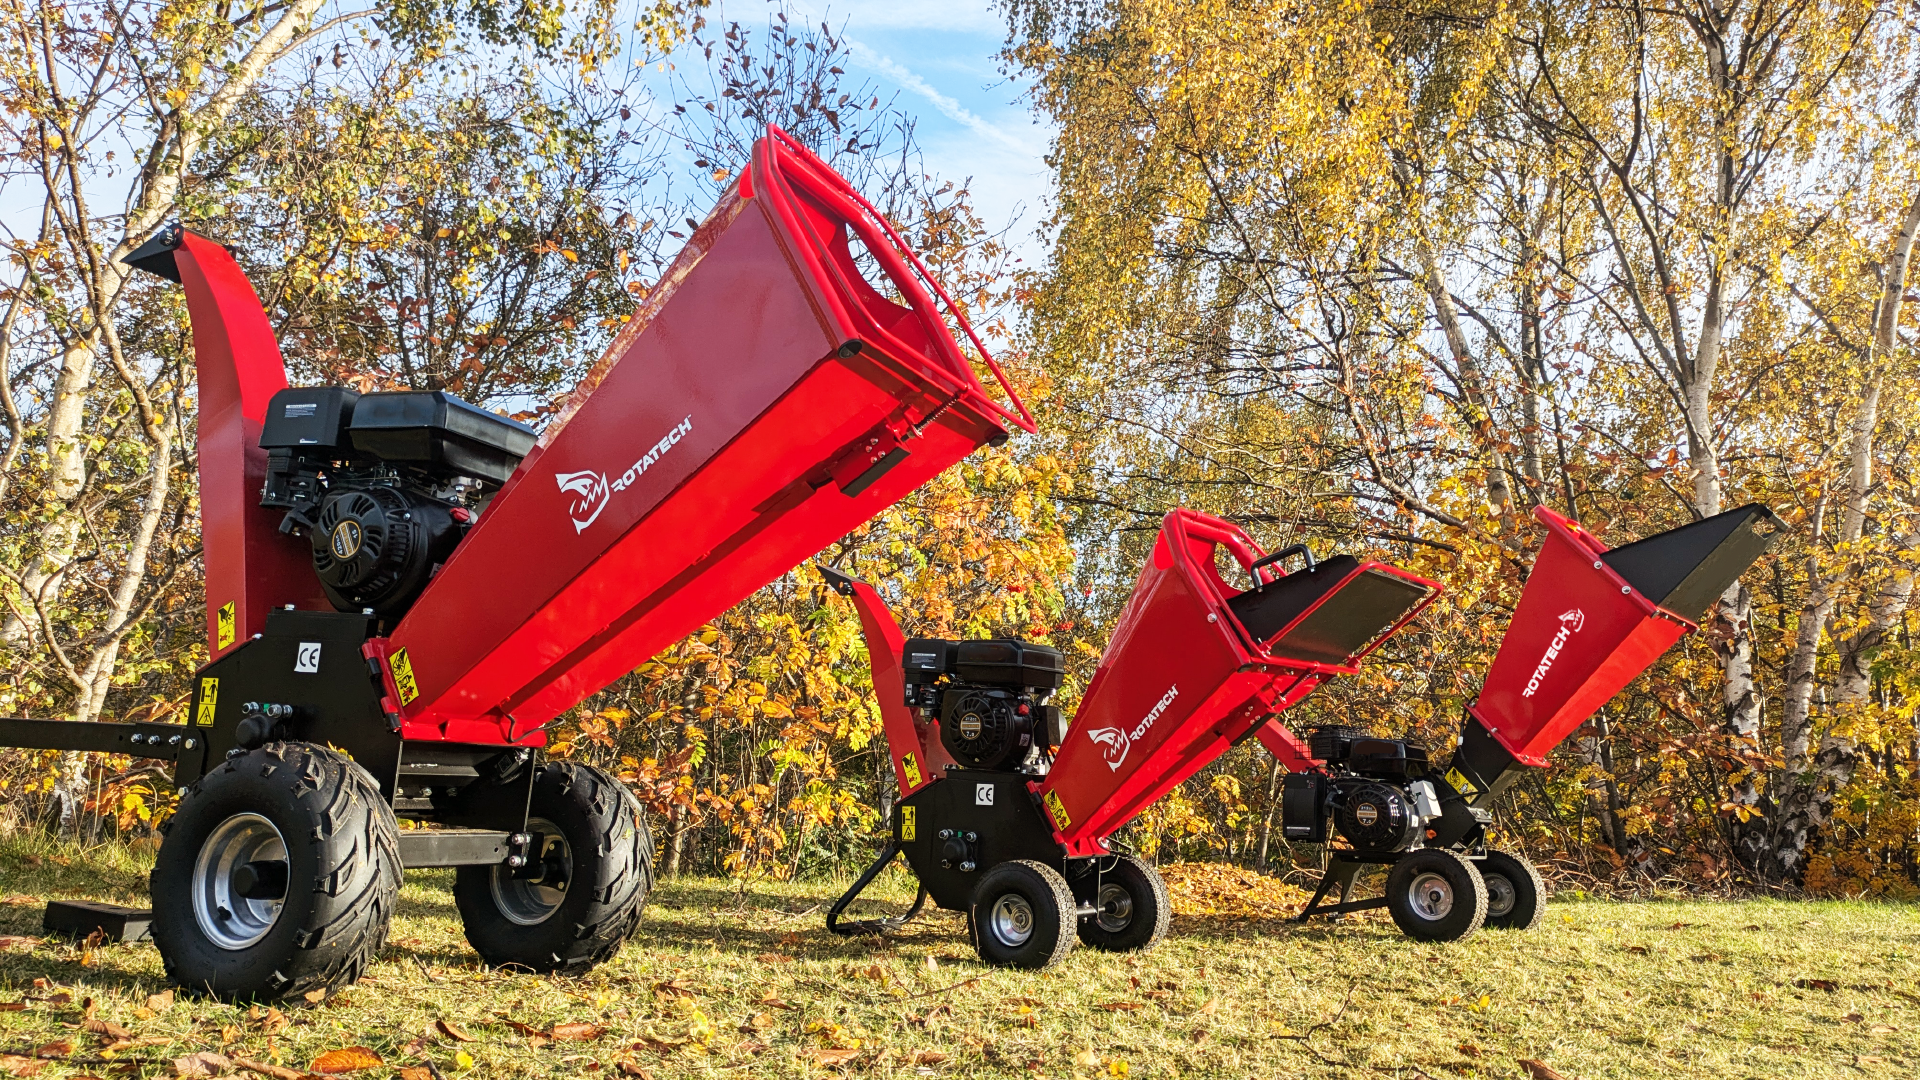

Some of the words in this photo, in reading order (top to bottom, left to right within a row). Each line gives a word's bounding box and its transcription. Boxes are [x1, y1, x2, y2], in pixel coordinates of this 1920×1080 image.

[610, 416, 693, 492] ROTATECH
[299, 647, 319, 668] CE
[1522, 626, 1571, 697] ROTATECH
[1129, 685, 1179, 741] ROTATECH
[977, 787, 993, 803] CE
